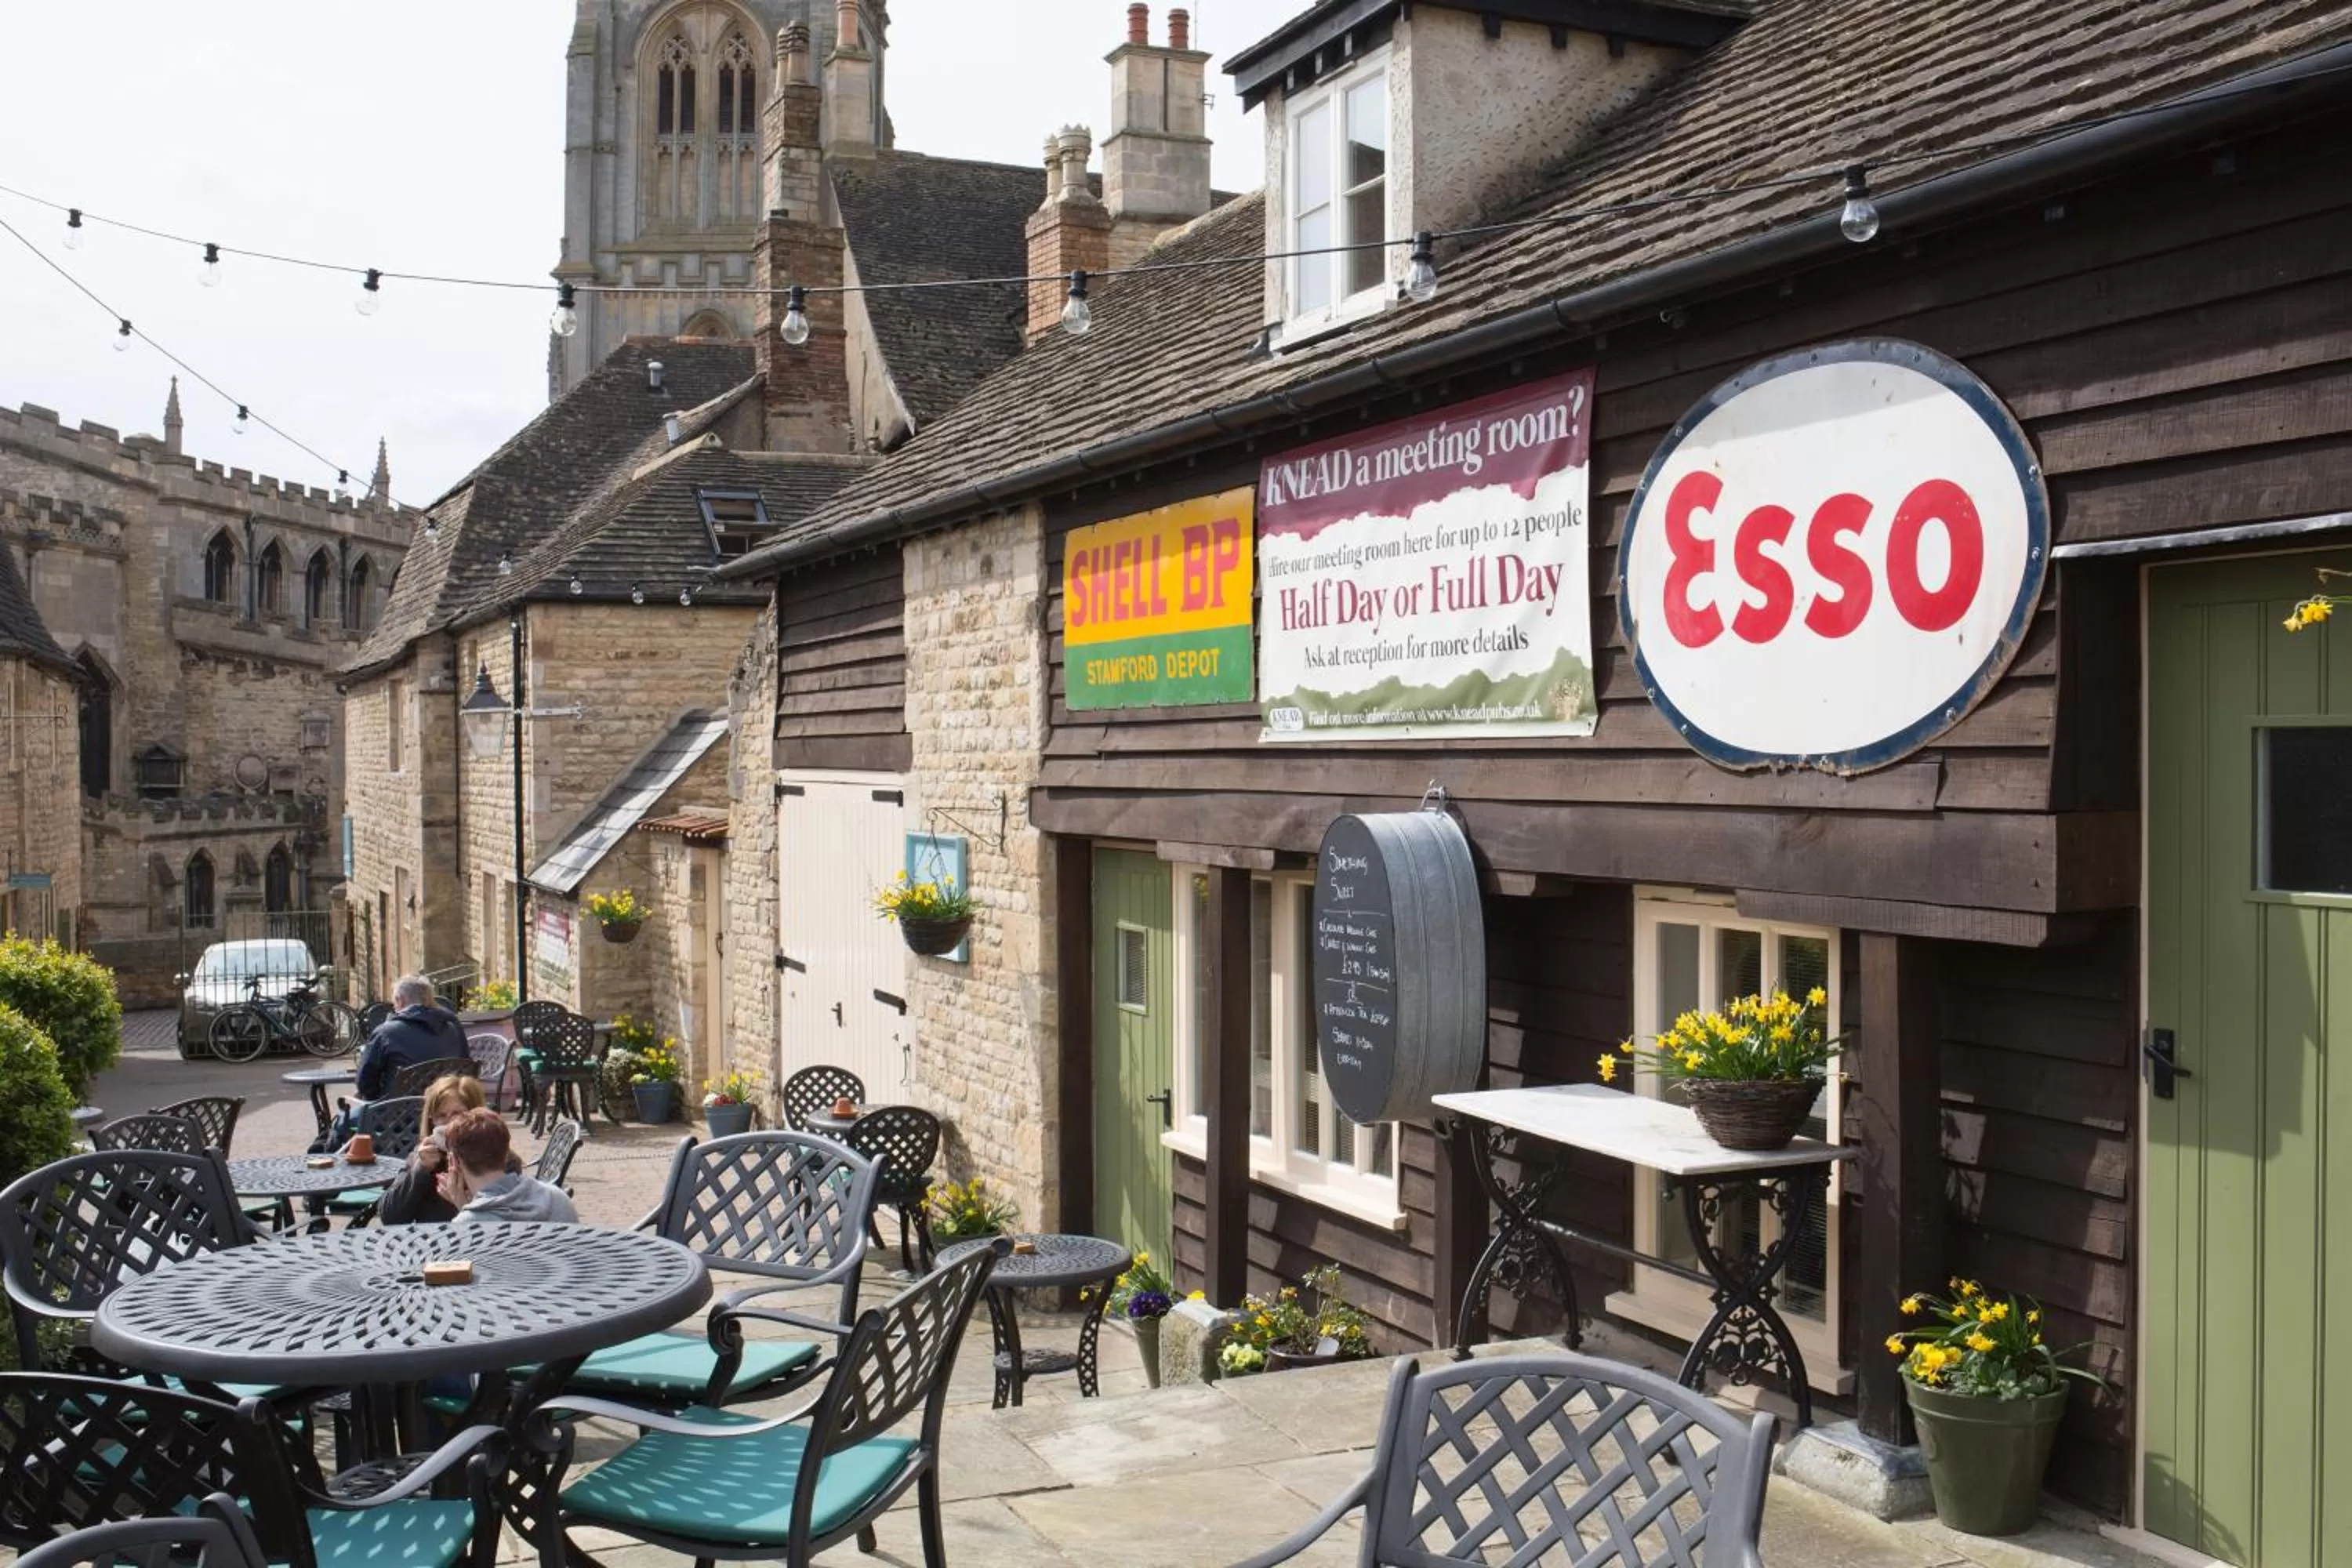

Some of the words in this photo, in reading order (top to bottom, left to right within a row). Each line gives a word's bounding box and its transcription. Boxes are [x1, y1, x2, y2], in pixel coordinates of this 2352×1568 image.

[1265, 448, 1352, 507] KNEAD
[1356, 456, 1370, 487] a
[1375, 420, 1483, 475] meeting
[1487, 385, 1584, 456] room?
[1070, 534, 1167, 627] SHELL
[1181, 517, 1241, 613] BP
[1291, 555, 1312, 572] our
[1313, 543, 1363, 570] meeting
[1365, 543, 1401, 561] room
[1403, 531, 1432, 554] here
[1436, 524, 1457, 549] for
[1459, 525, 1480, 550] up
[1483, 521, 1498, 543] to
[1504, 519, 1521, 538] 12
[1524, 502, 1581, 542] people
[1279, 578, 1332, 631] Half
[1337, 579, 1388, 635] Day
[1393, 583, 1424, 618] or
[1430, 554, 1489, 613] Full
[1497, 554, 1565, 617] Day
[1086, 655, 1157, 685] STAMFORD
[1167, 648, 1220, 678] DEPOT
[1304, 644, 1327, 669] Ask
[1327, 645, 1341, 666] at
[1343, 639, 1403, 670] reception
[1406, 633, 1428, 659] for
[1430, 638, 1469, 658] more
[1473, 624, 1530, 653] details
